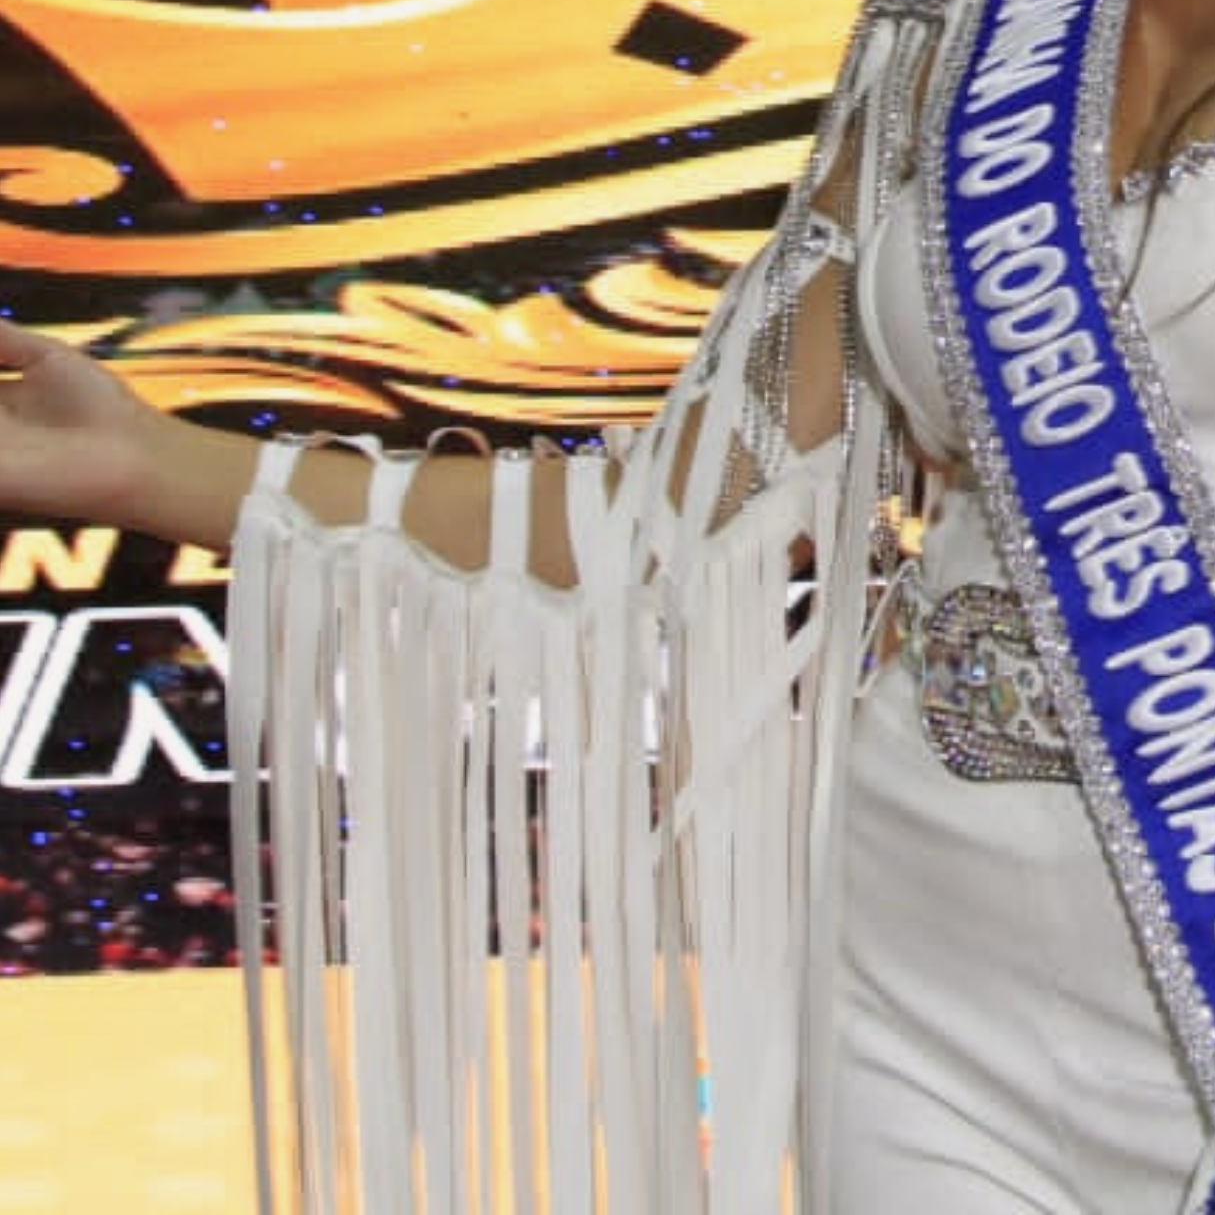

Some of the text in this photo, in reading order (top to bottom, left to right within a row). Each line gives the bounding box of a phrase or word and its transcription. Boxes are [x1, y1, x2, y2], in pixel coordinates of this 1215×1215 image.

[956, 102, 1056, 198] DO
[962, 201, 1118, 447] RODEIO
[1043, 451, 1190, 620] TRÊS
